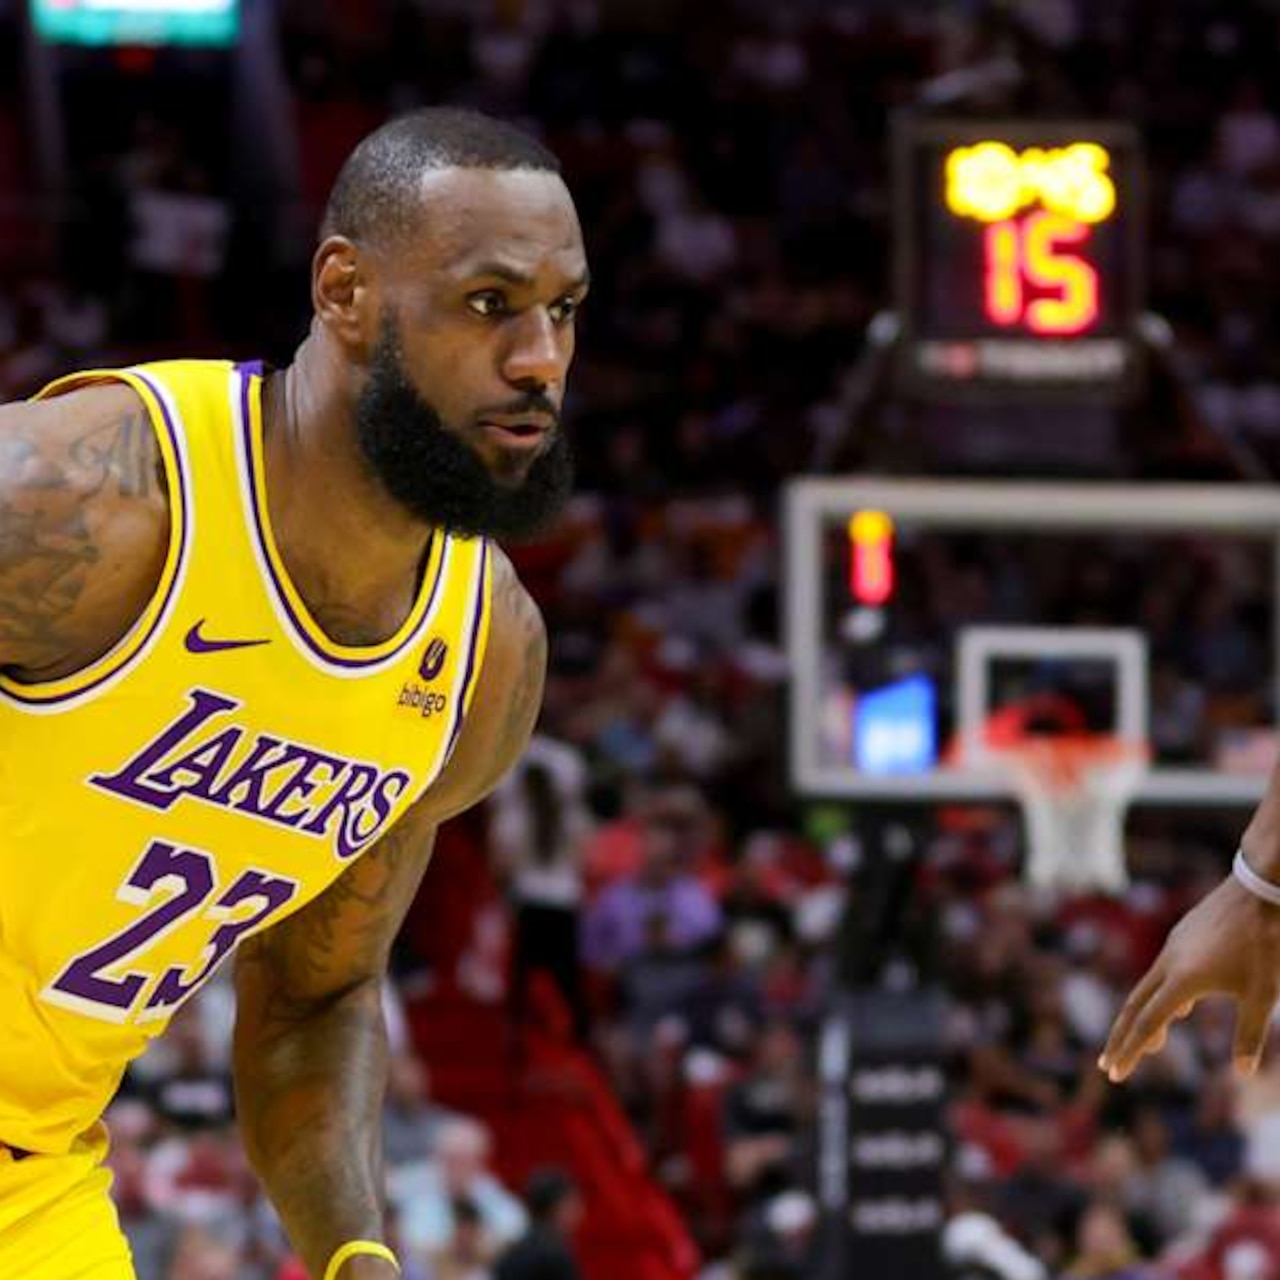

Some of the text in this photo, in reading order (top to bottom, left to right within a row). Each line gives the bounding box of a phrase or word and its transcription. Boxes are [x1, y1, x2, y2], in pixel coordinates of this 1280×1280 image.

[984, 212, 1098, 335] 15
[398, 683, 446, 717] bibigo
[87, 688, 412, 860] LAKERS
[42, 840, 300, 1023] 23
